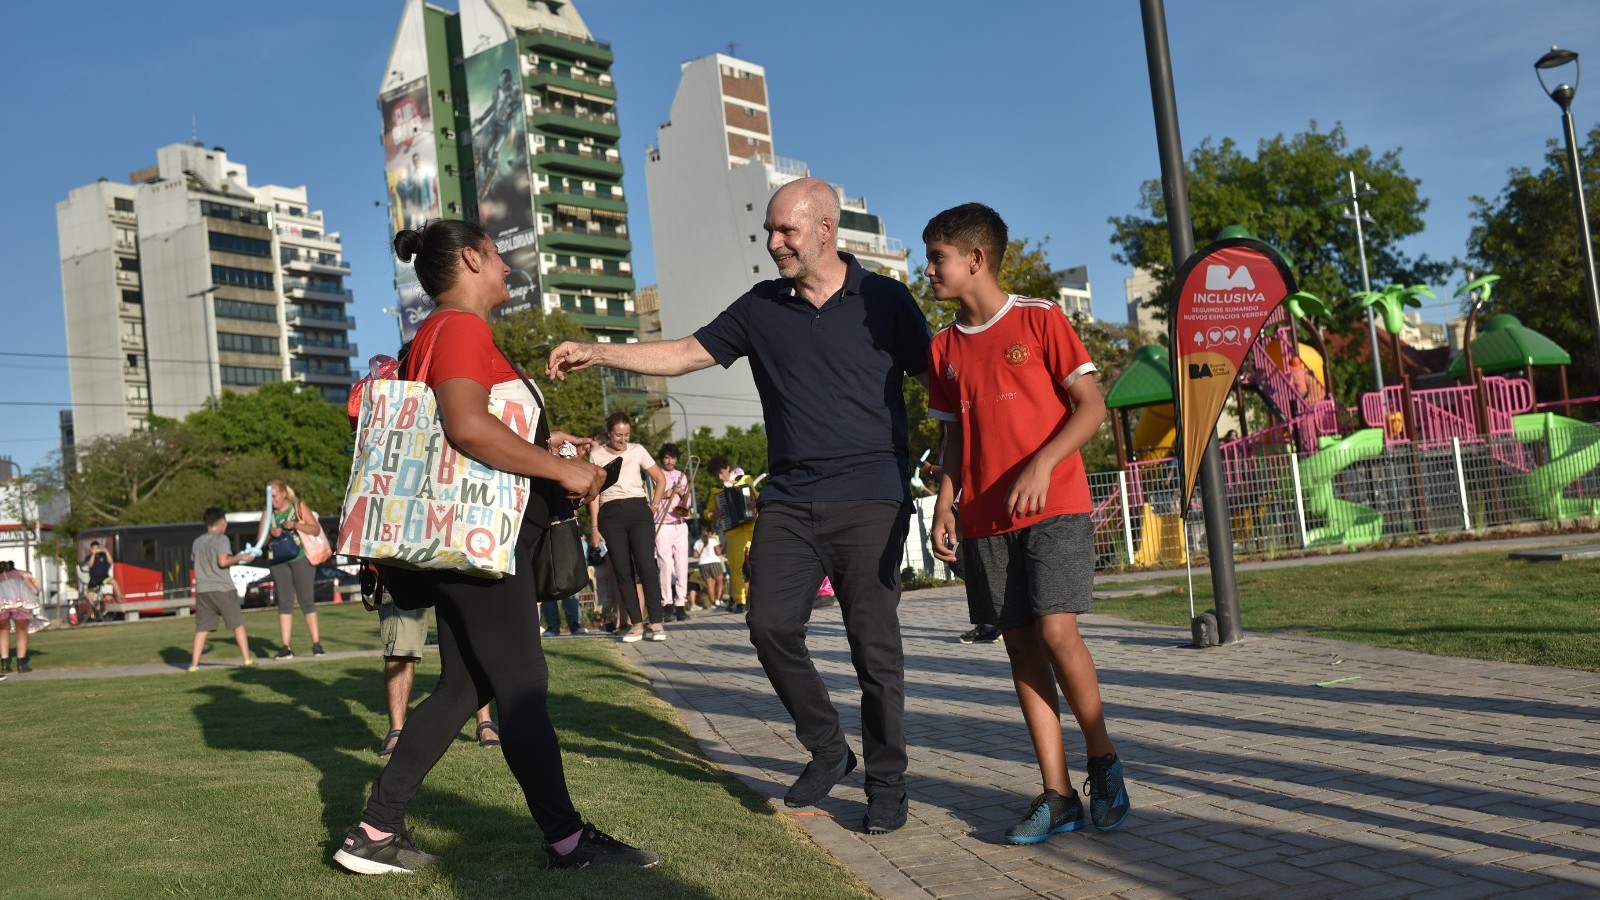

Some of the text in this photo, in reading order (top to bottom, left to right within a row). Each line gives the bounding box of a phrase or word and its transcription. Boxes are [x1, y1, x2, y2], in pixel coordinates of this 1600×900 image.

[1205, 264, 1256, 291] BA
[1193, 292, 1265, 304] INCLUSIVA
[1192, 305, 1259, 314] SEGUIMOS SUMANDO
[1241, 311, 1268, 319] VERDES
[1189, 363, 1214, 380] BA
